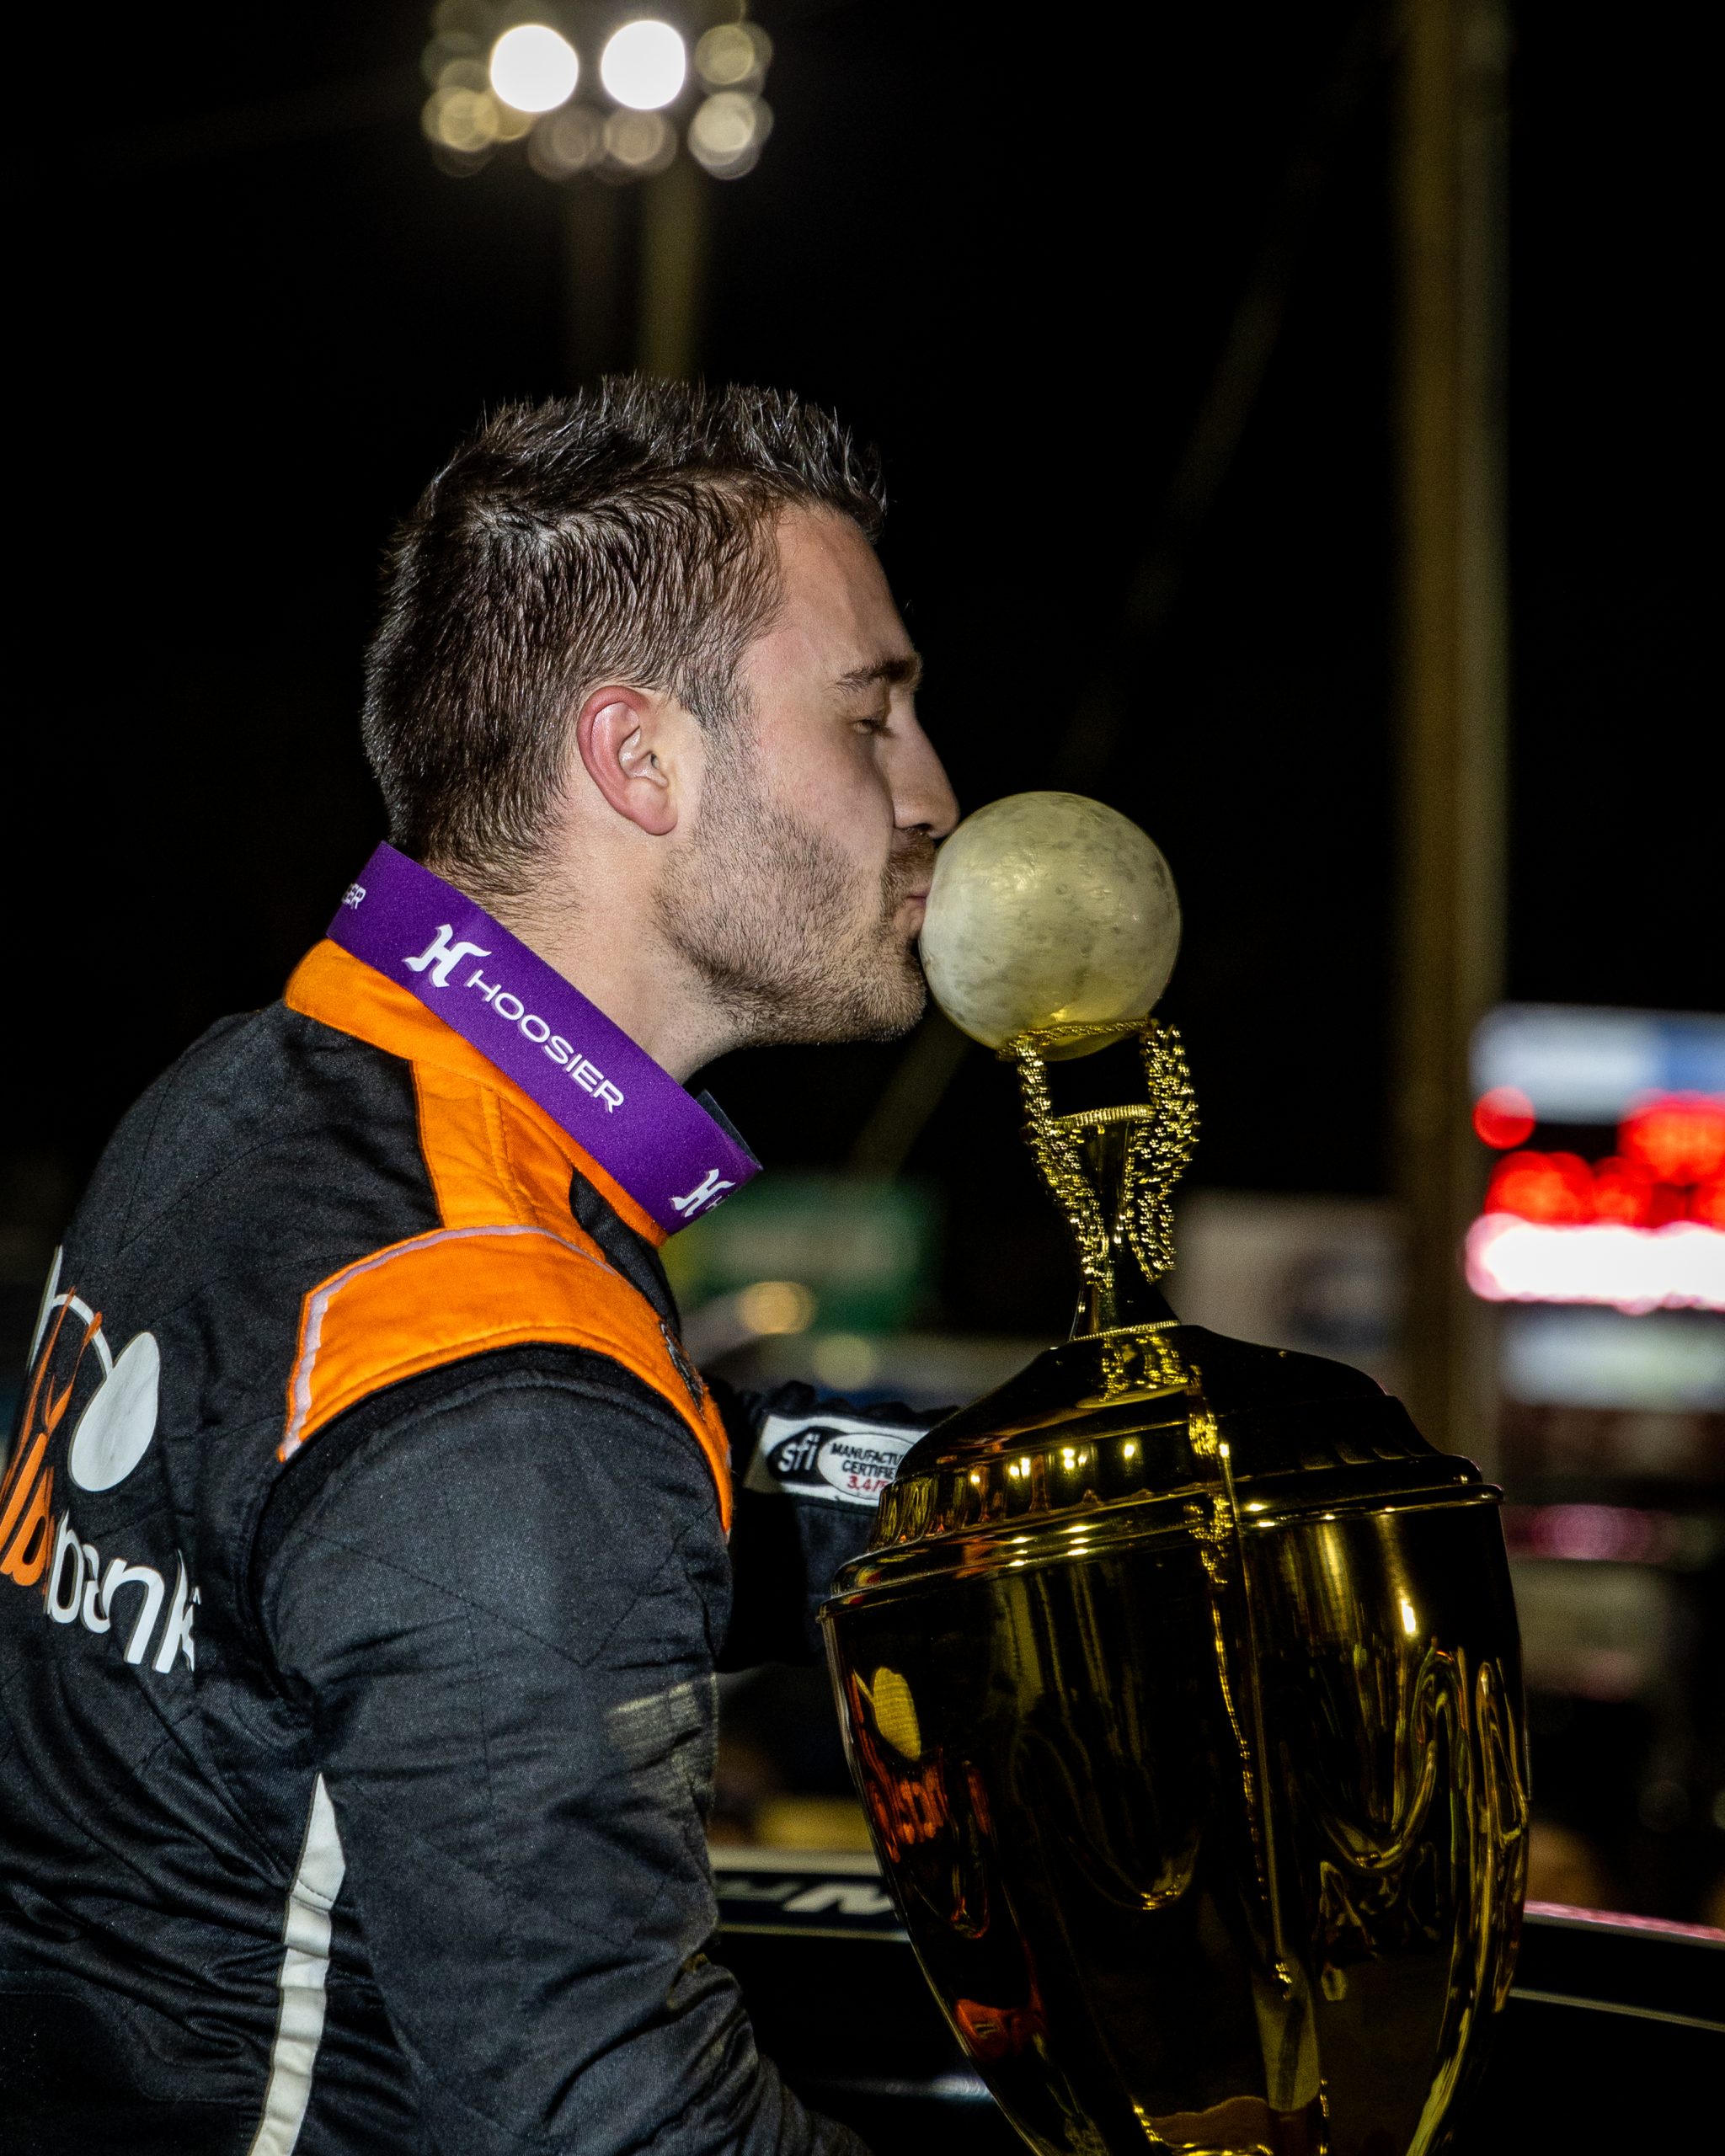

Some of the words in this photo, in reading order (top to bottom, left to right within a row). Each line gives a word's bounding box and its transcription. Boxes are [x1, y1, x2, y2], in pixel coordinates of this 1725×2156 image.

[466, 969, 625, 1114] HOOSIER
[830, 1442, 905, 1465] MANUFACTU
[842, 1460, 897, 1481] CERTIFIE
